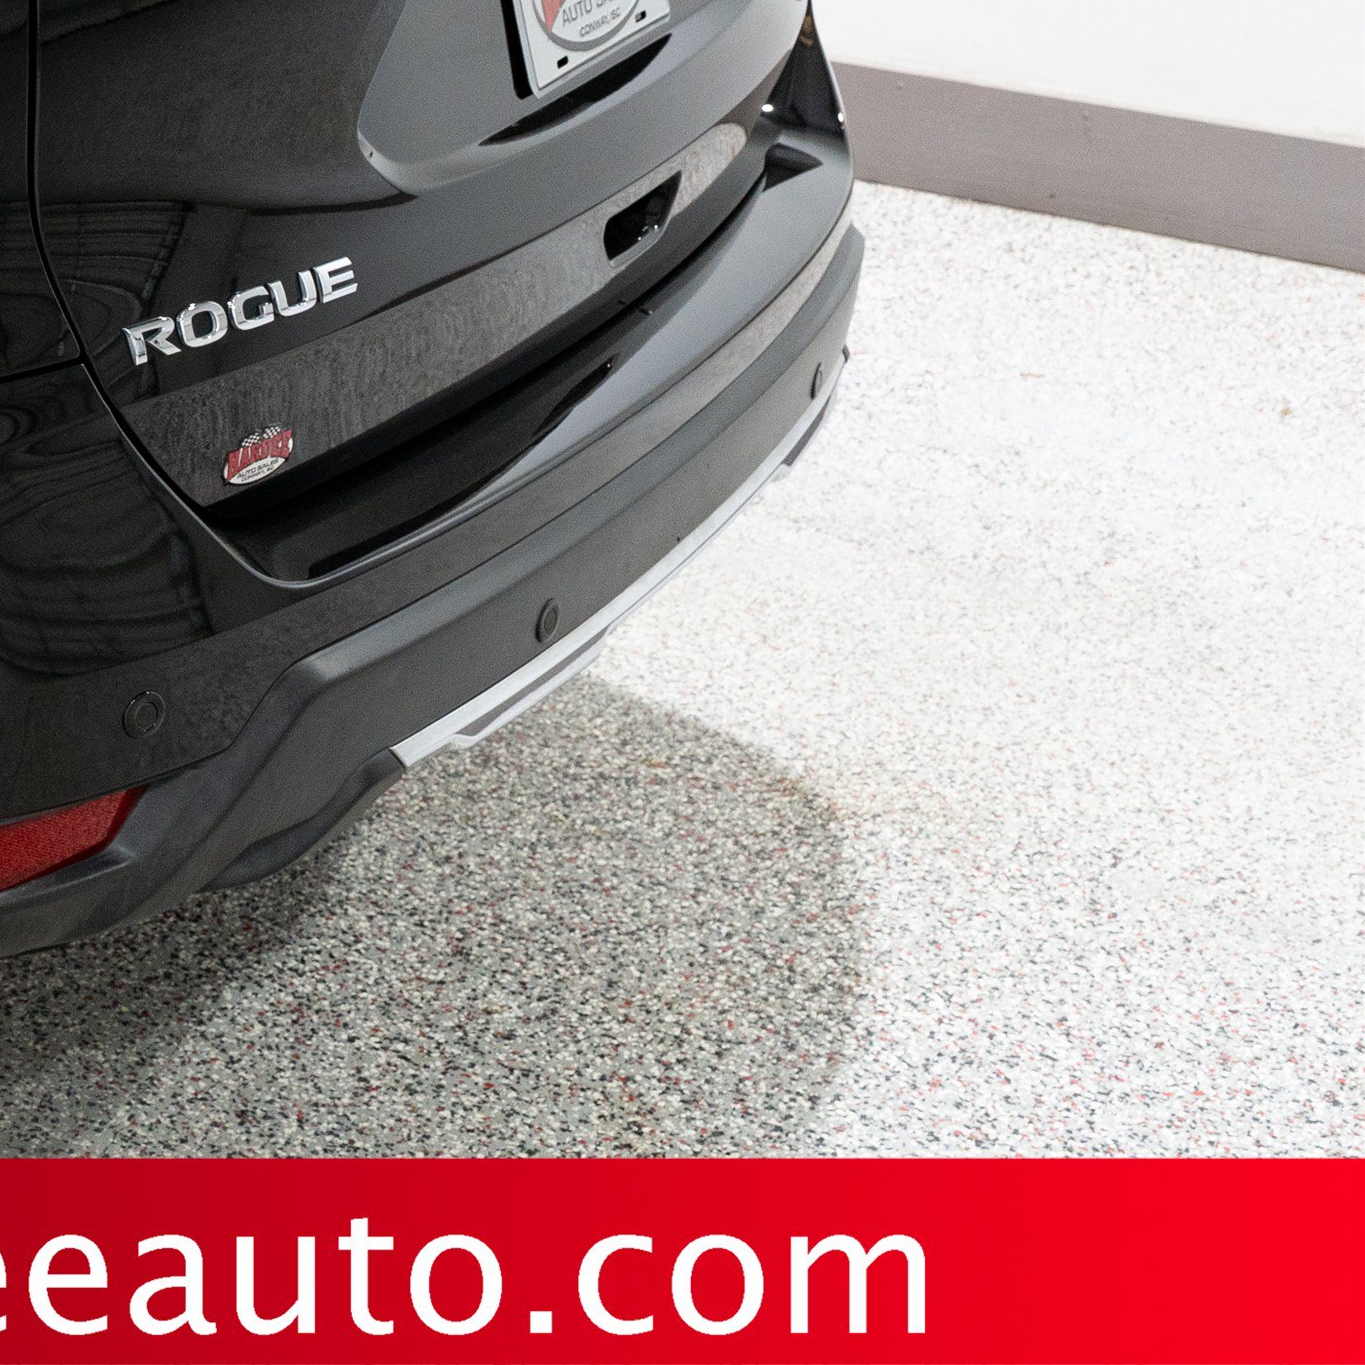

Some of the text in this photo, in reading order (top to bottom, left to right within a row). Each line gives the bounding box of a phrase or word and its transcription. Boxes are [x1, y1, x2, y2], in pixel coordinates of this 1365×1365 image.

[122, 256, 358, 366] ROGUE
[226, 428, 292, 483] HARDEE
[237, 467, 257, 479] AUTO
